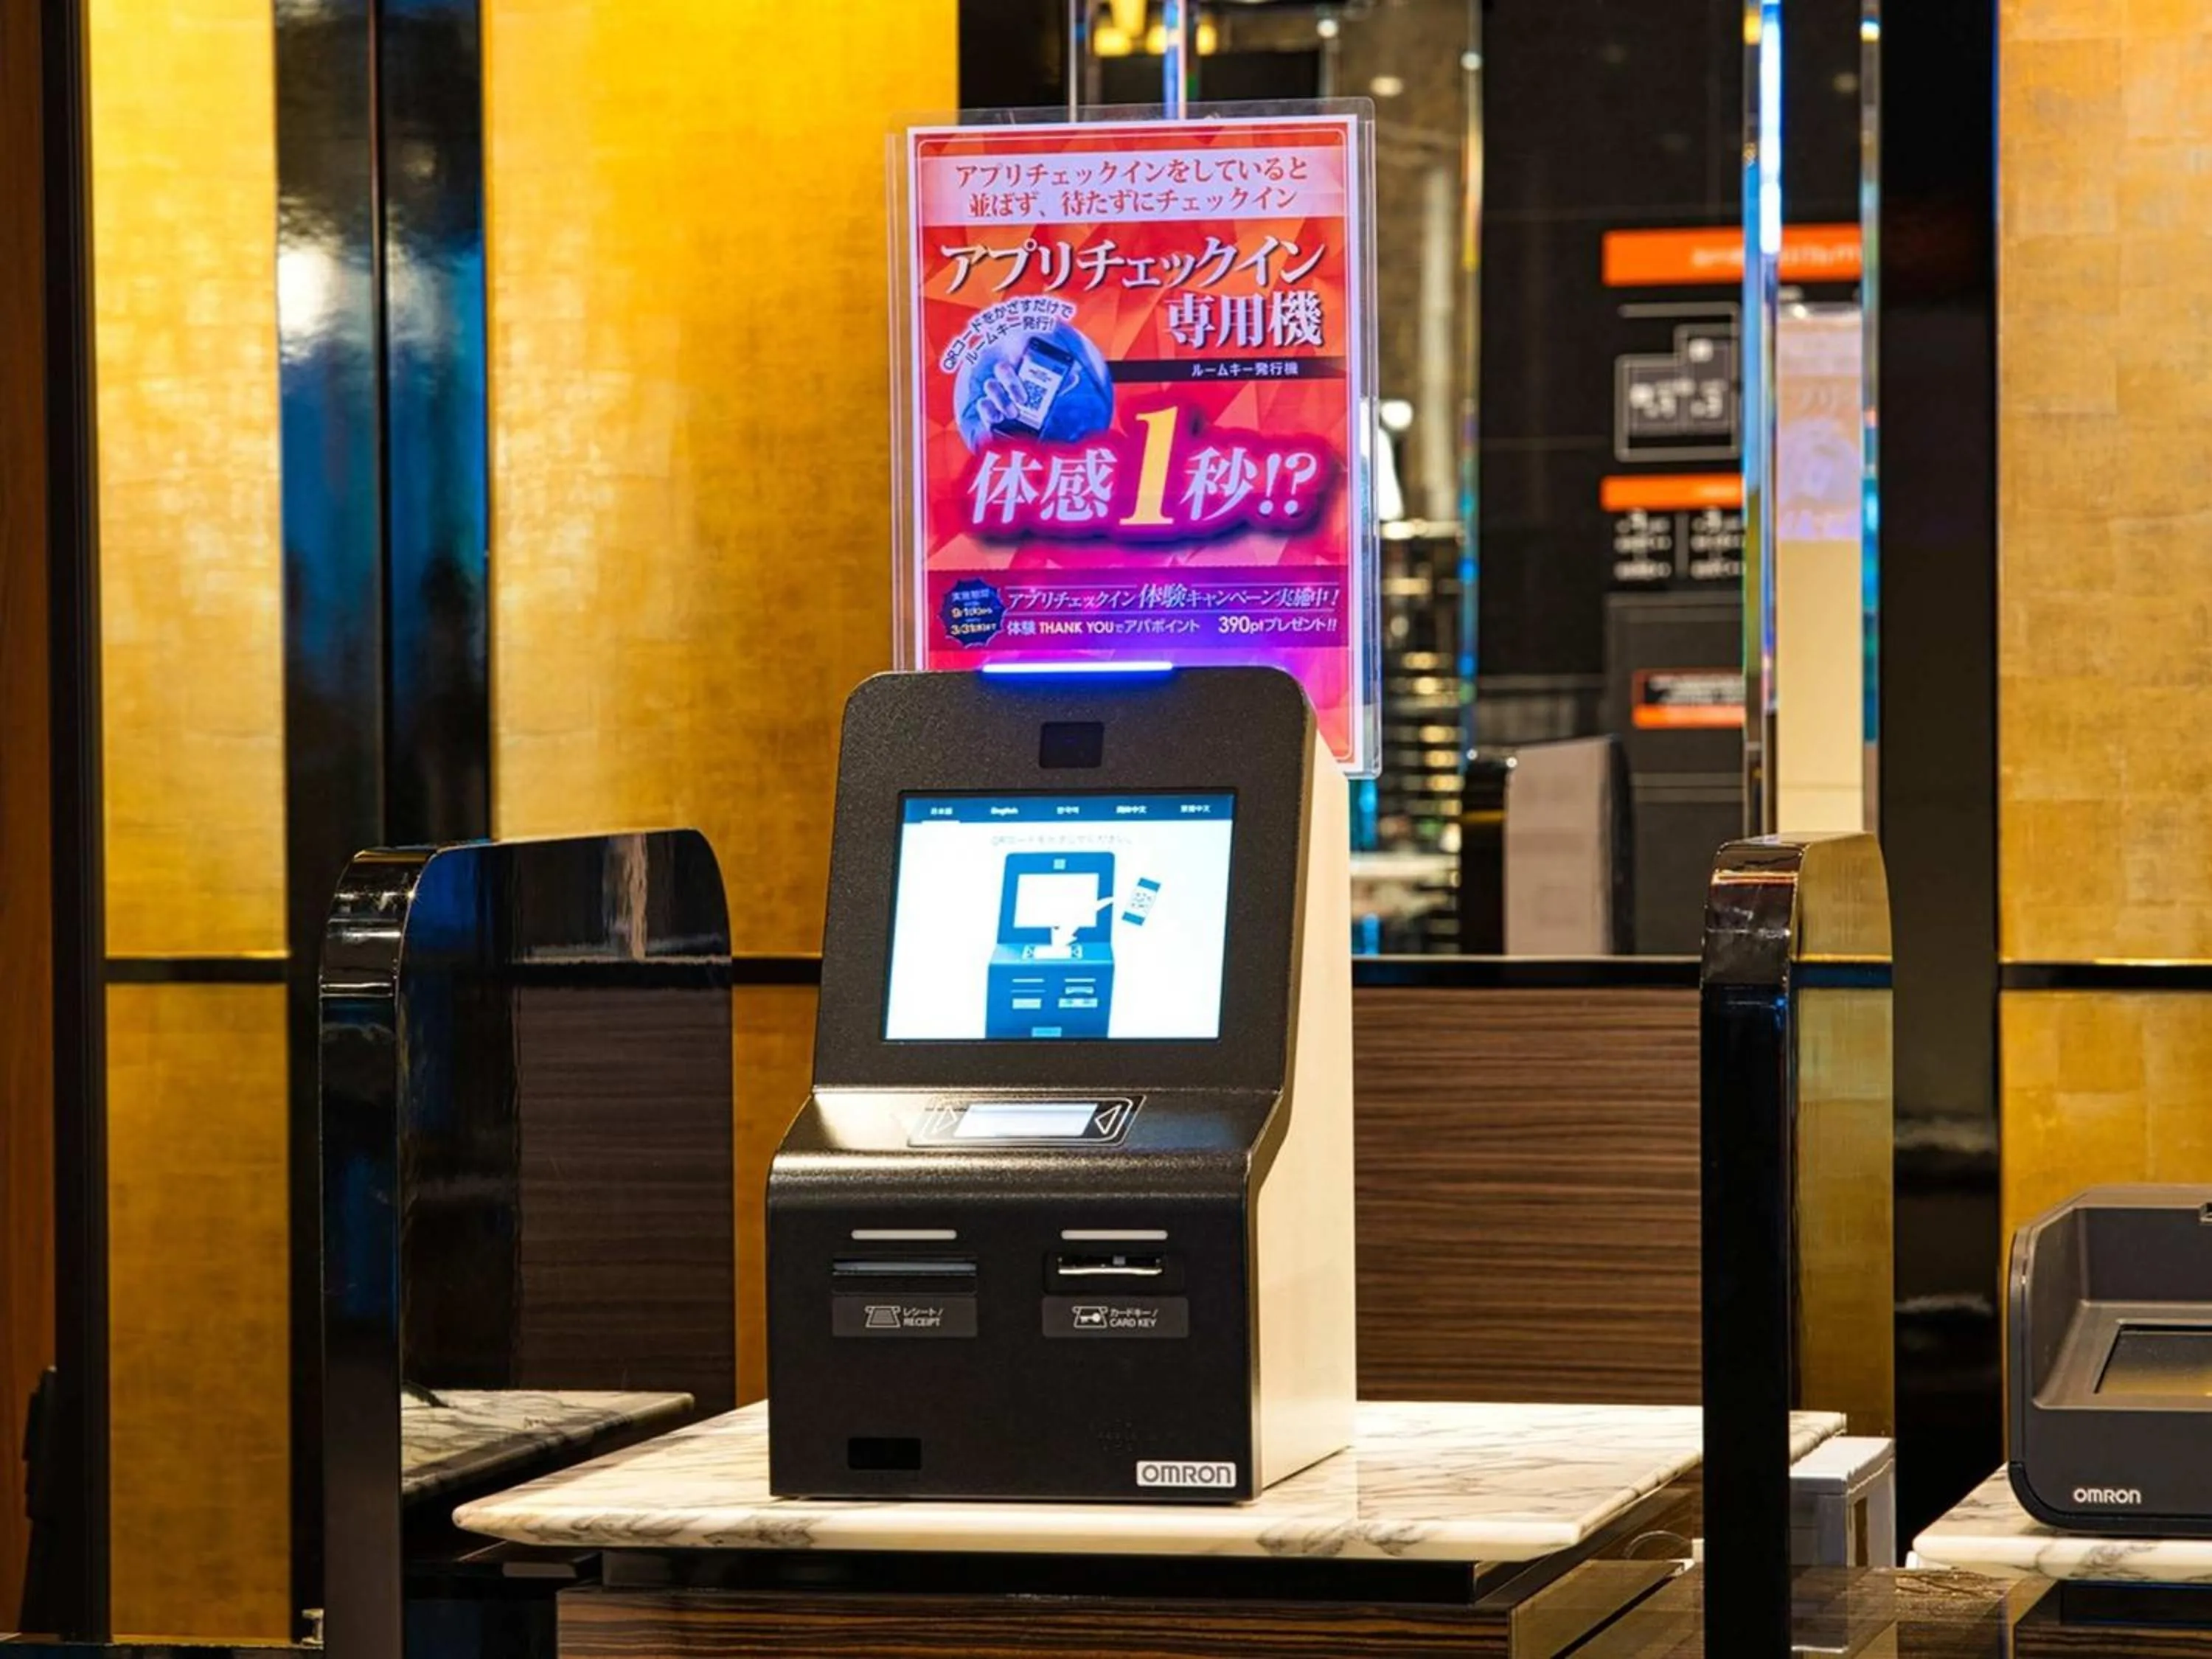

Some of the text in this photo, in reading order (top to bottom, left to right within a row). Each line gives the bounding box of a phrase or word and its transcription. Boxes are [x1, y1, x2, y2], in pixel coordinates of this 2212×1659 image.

[956, 156, 1307, 189] アプリチェックインをしていると
[969, 186, 1297, 218] 並ばず、待たずにチェックイン
[941, 235, 1325, 294] アプリチェックイン
[1163, 291, 1324, 349] 専用機
[1192, 361, 1298, 377] ルームキー発行機
[1039, 622, 1083, 634] THANK
[903, 1318, 941, 1327] RECEIPT
[1109, 1318, 1157, 1328] CARD KEY
